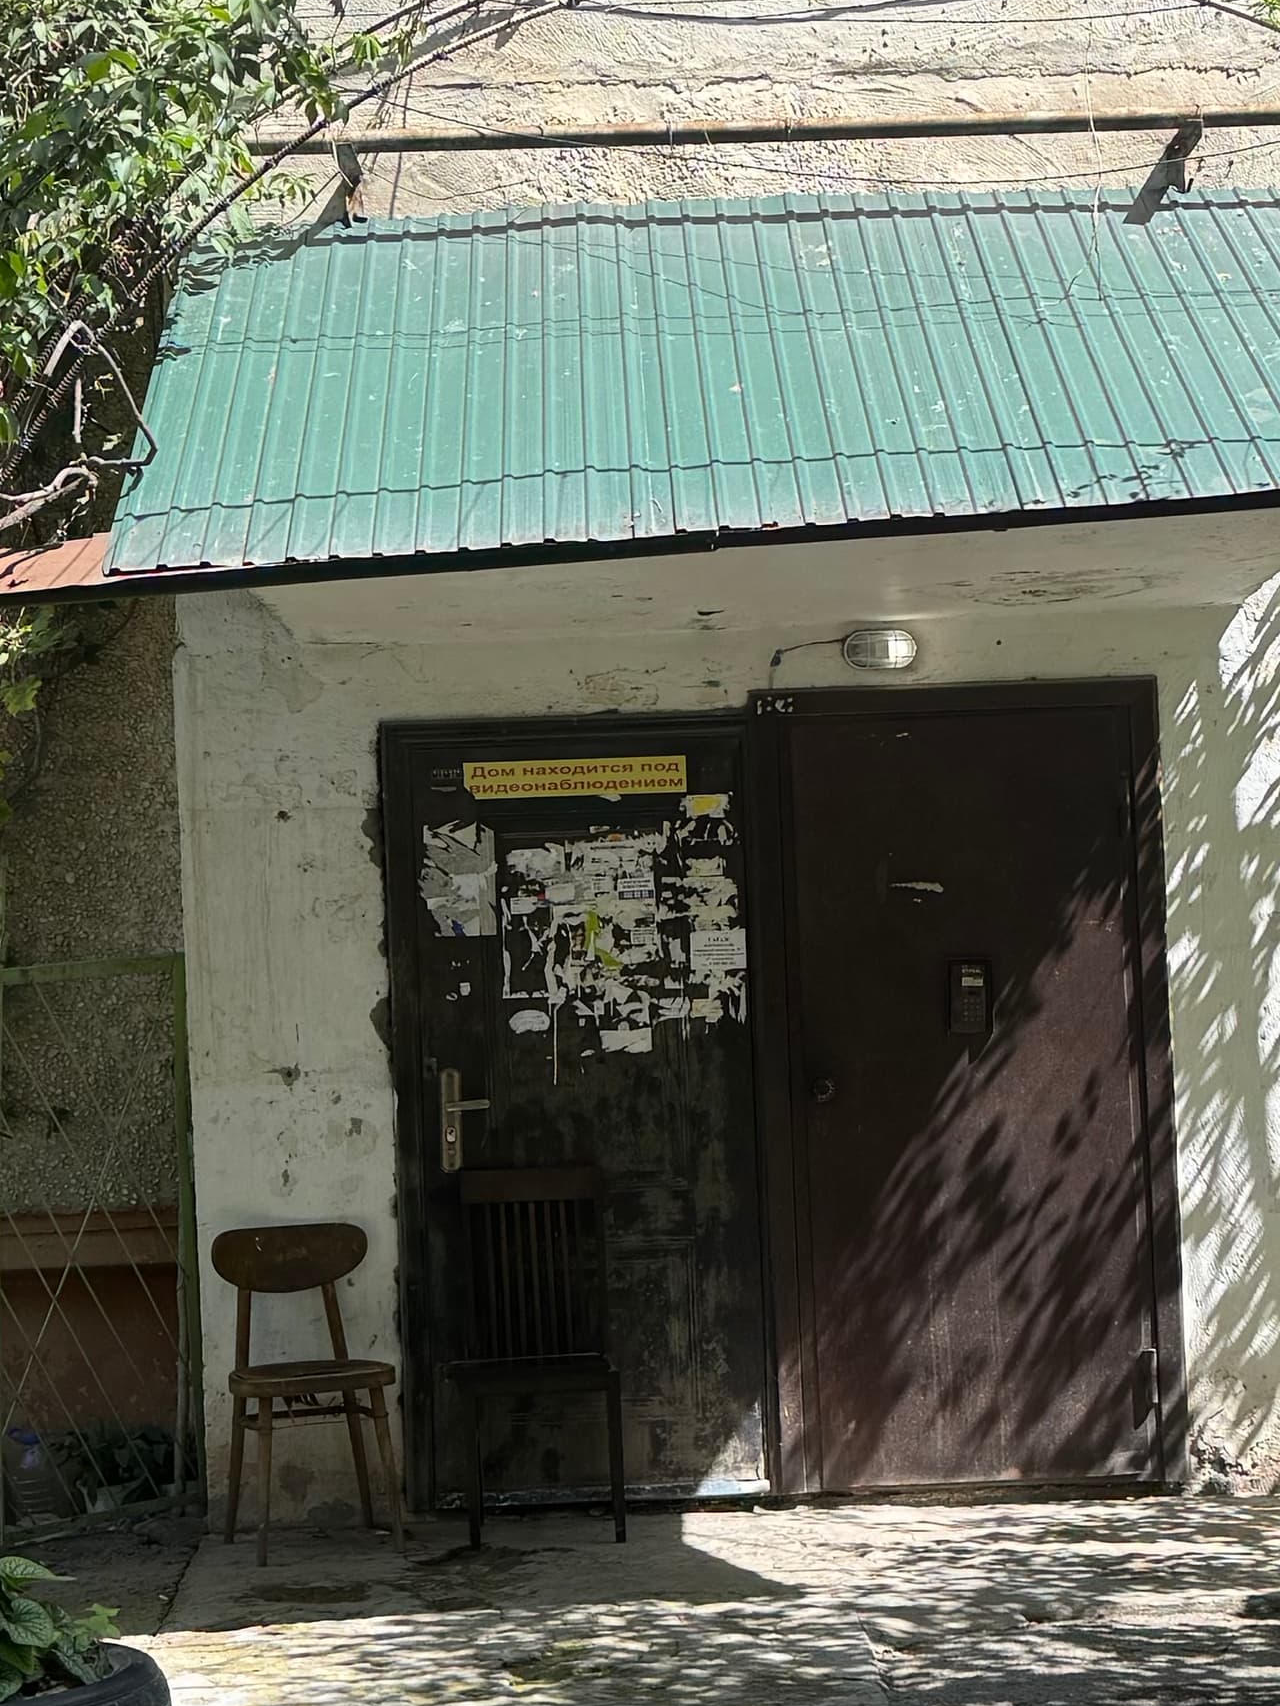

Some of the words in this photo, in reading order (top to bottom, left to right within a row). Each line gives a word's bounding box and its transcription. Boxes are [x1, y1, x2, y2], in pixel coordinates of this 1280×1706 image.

[471, 766, 515, 779] Дом
[522, 763, 633, 777] находится
[641, 761, 680, 773] под
[469, 777, 683, 795] видеонаблюдением
